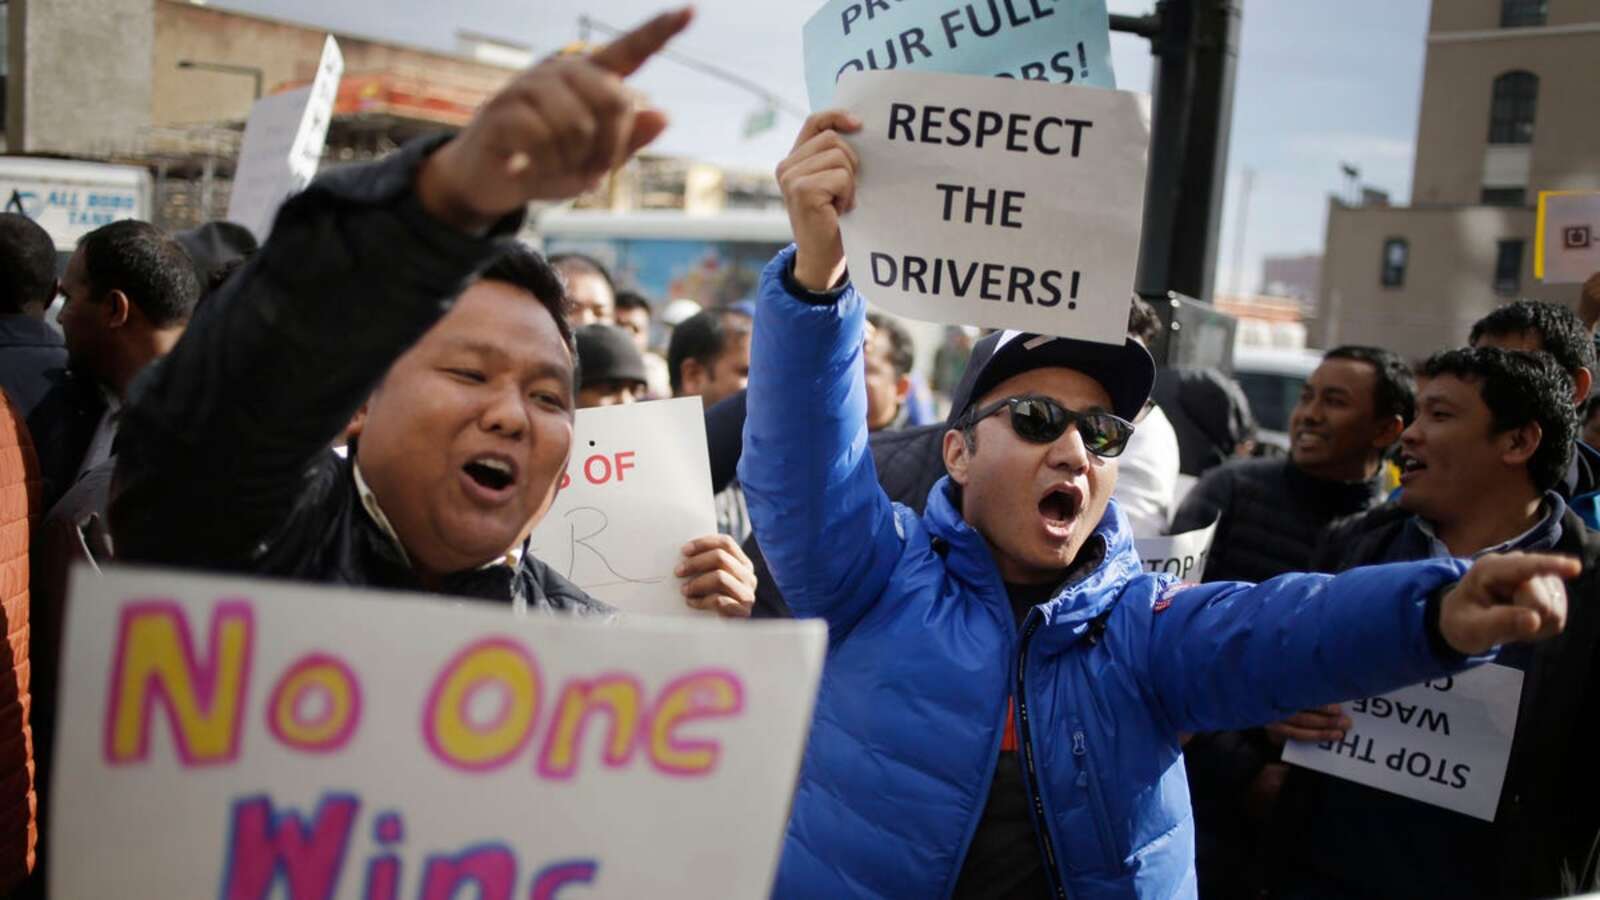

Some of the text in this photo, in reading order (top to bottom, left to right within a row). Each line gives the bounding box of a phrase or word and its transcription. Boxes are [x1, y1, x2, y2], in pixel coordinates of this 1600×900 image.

[940, 0, 1054, 49] FULL
[888, 102, 1093, 158] RESPECT
[48, 191, 79, 208] ALL
[936, 183, 1026, 229] THE
[870, 251, 1081, 310] DRIVERS!
[583, 451, 636, 486] OF
[1141, 555, 1195, 580] TOP
[104, 600, 745, 781] No One
[1352, 698, 1450, 737] WAGE
[1386, 748, 1471, 790] STOP
